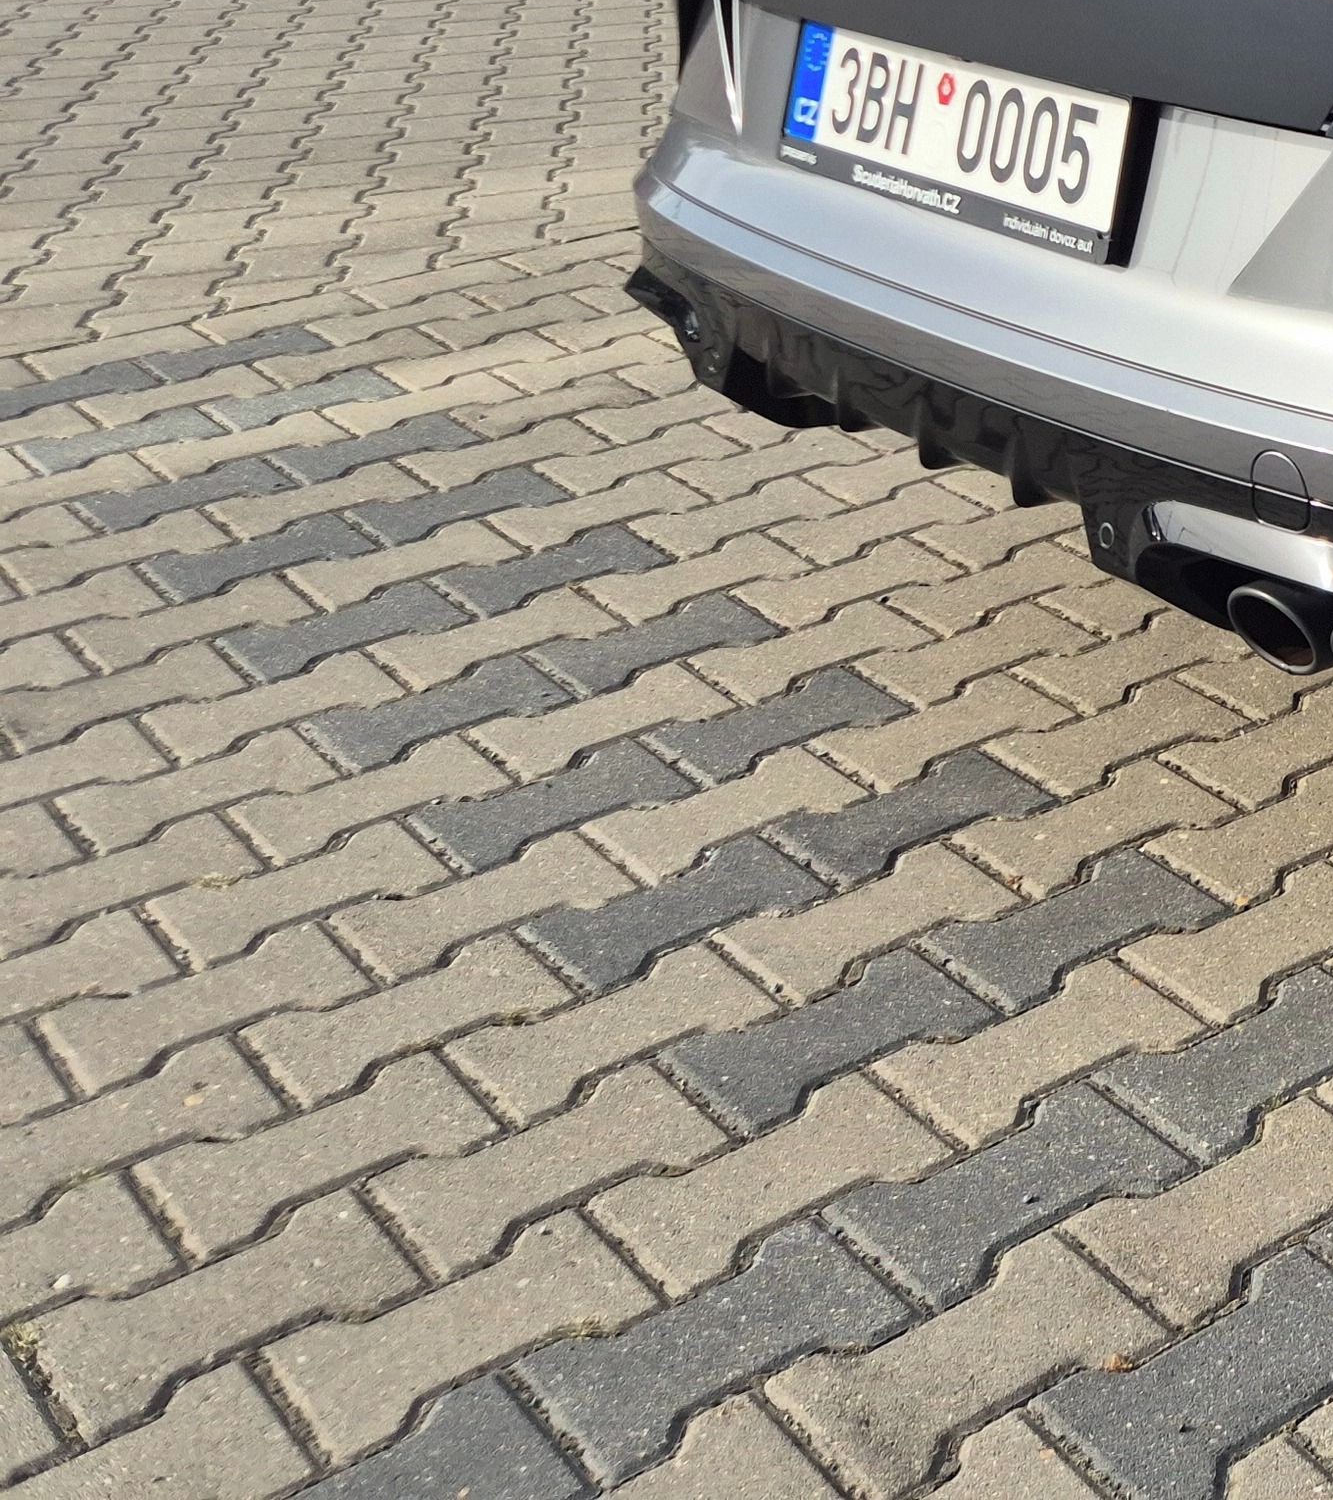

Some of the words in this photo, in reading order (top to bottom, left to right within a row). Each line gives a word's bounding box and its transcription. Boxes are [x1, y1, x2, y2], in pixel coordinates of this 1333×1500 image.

[792, 97, 819, 126] CZ
[832, 47, 925, 156] 3BH
[956, 79, 1100, 205] 0005
[1049, 229, 1076, 249] dovoz
